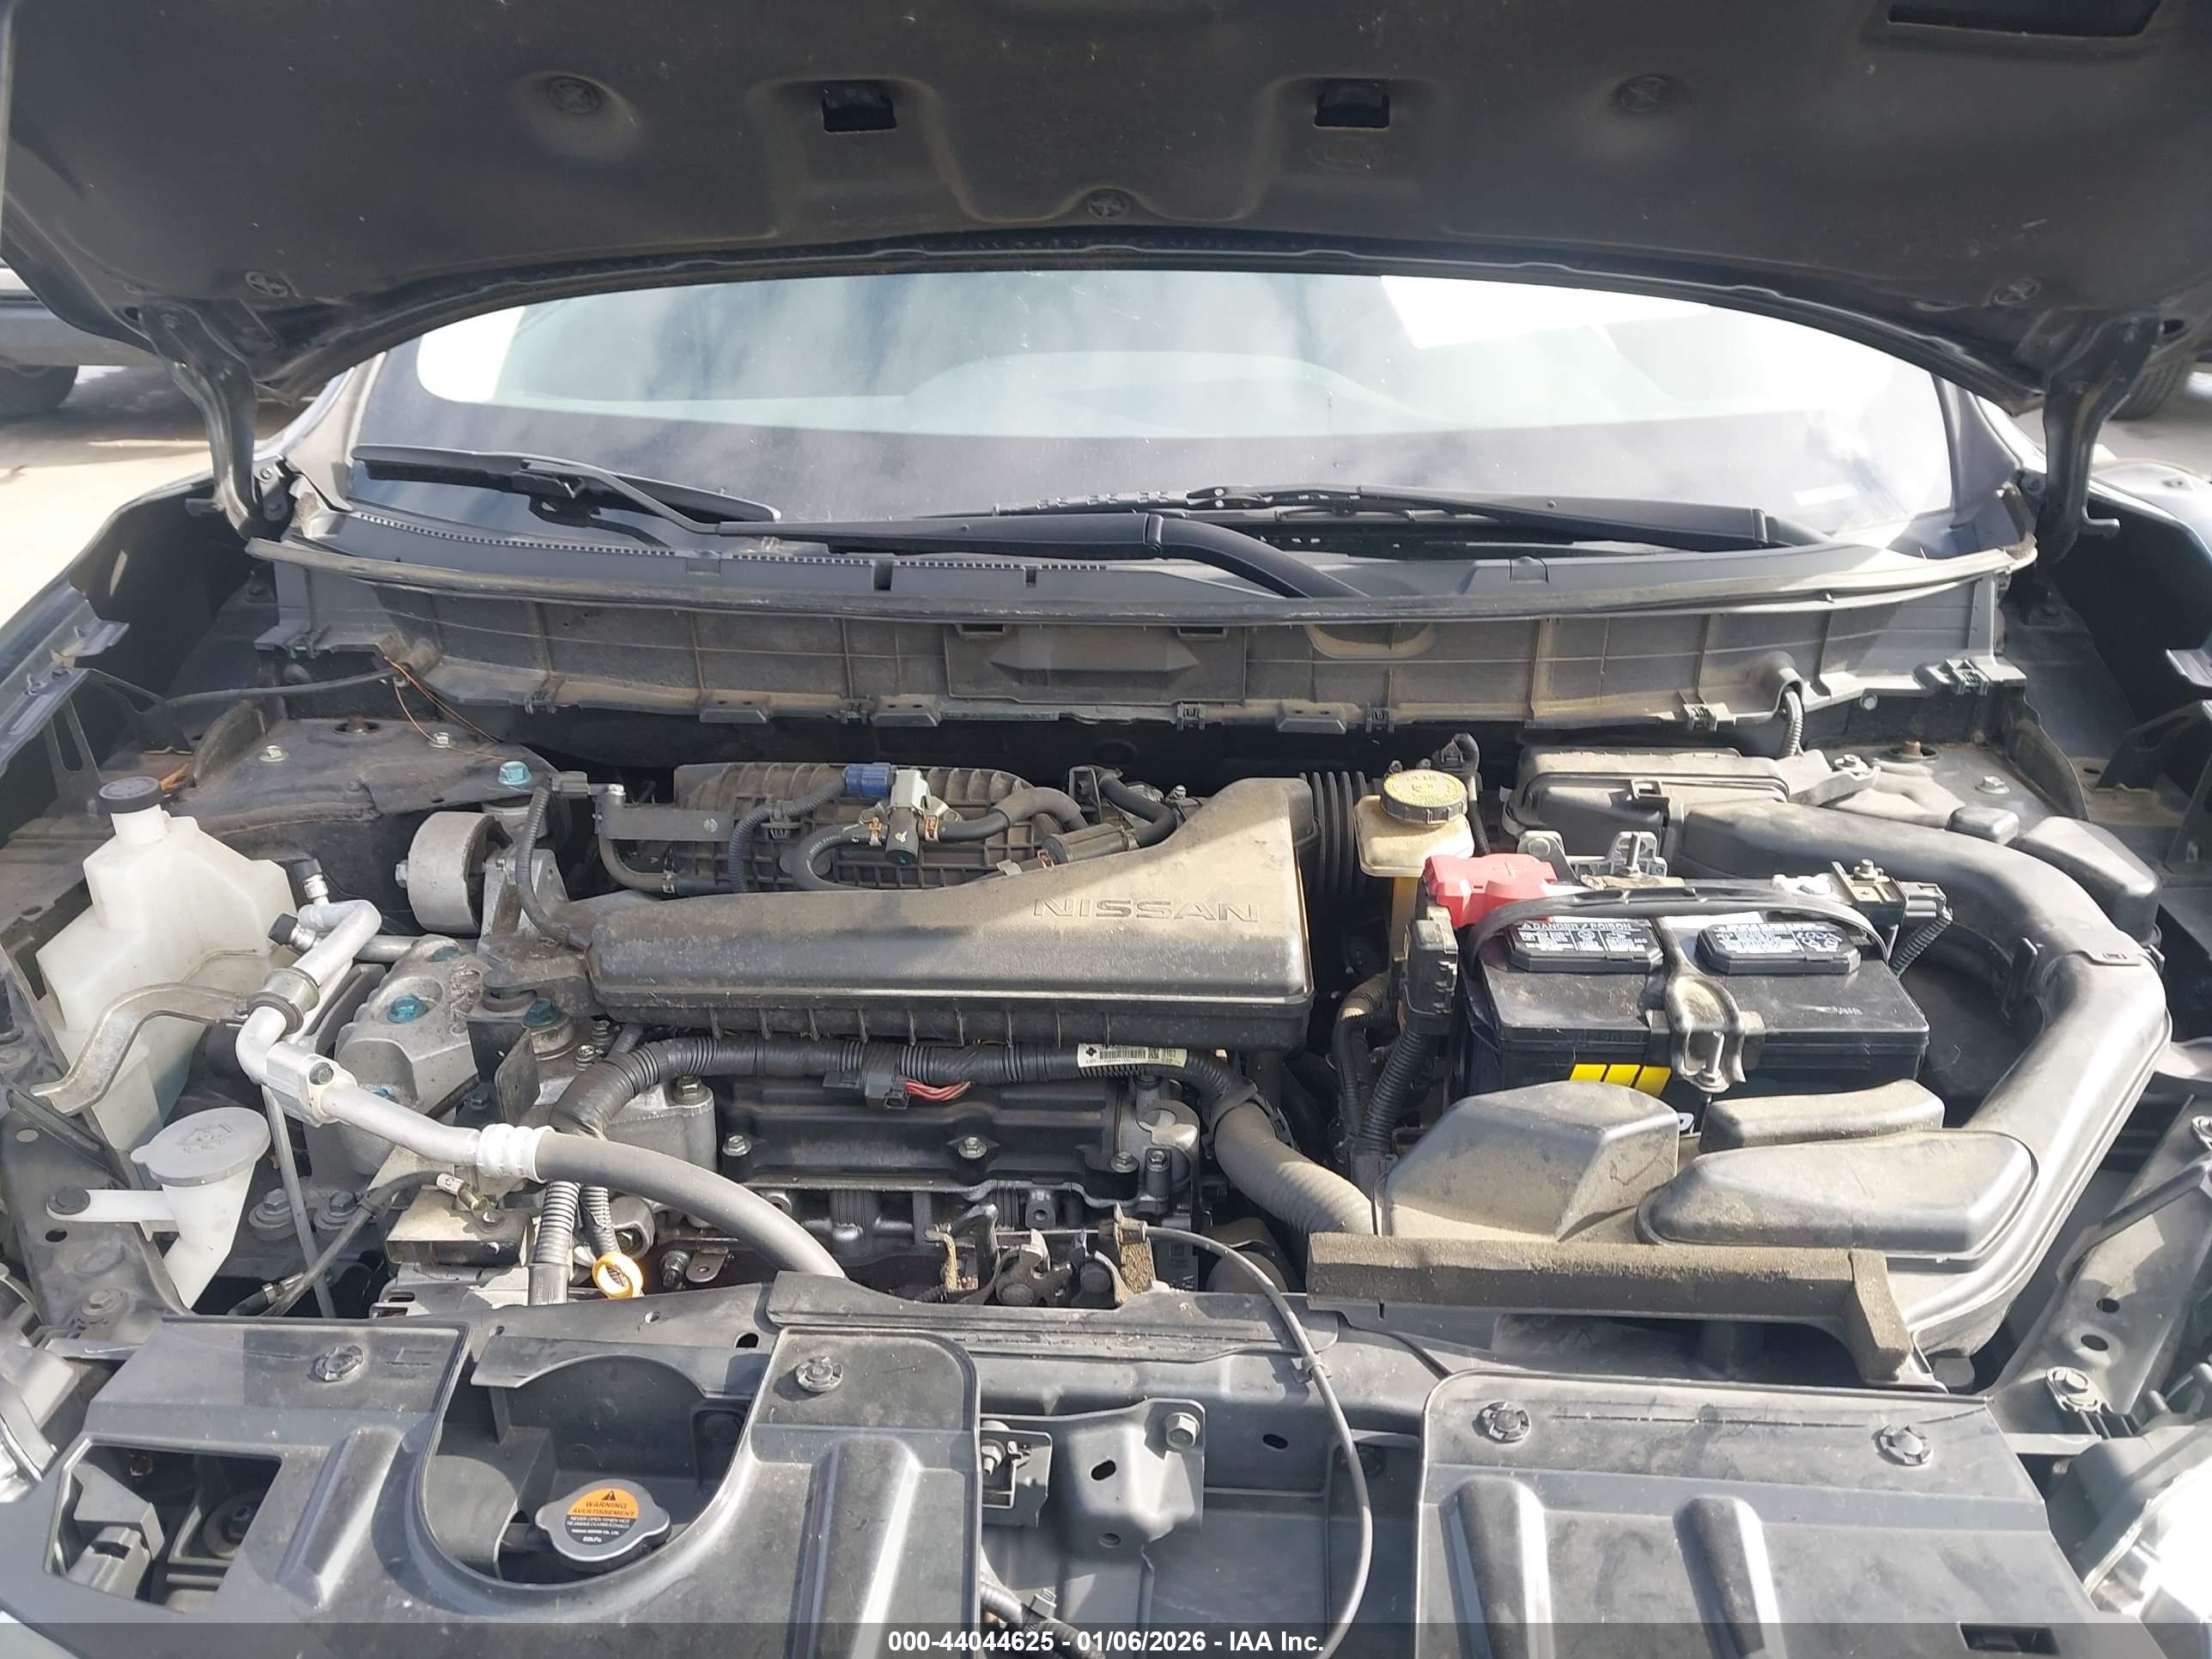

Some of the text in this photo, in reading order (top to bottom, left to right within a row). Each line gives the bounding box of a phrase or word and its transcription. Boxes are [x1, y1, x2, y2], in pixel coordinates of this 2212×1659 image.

[1033, 898, 1258, 923] NISSAN
[586, 1501, 628, 1510] WARNING
[573, 1508, 635, 1516] AVERTISSEMENT
